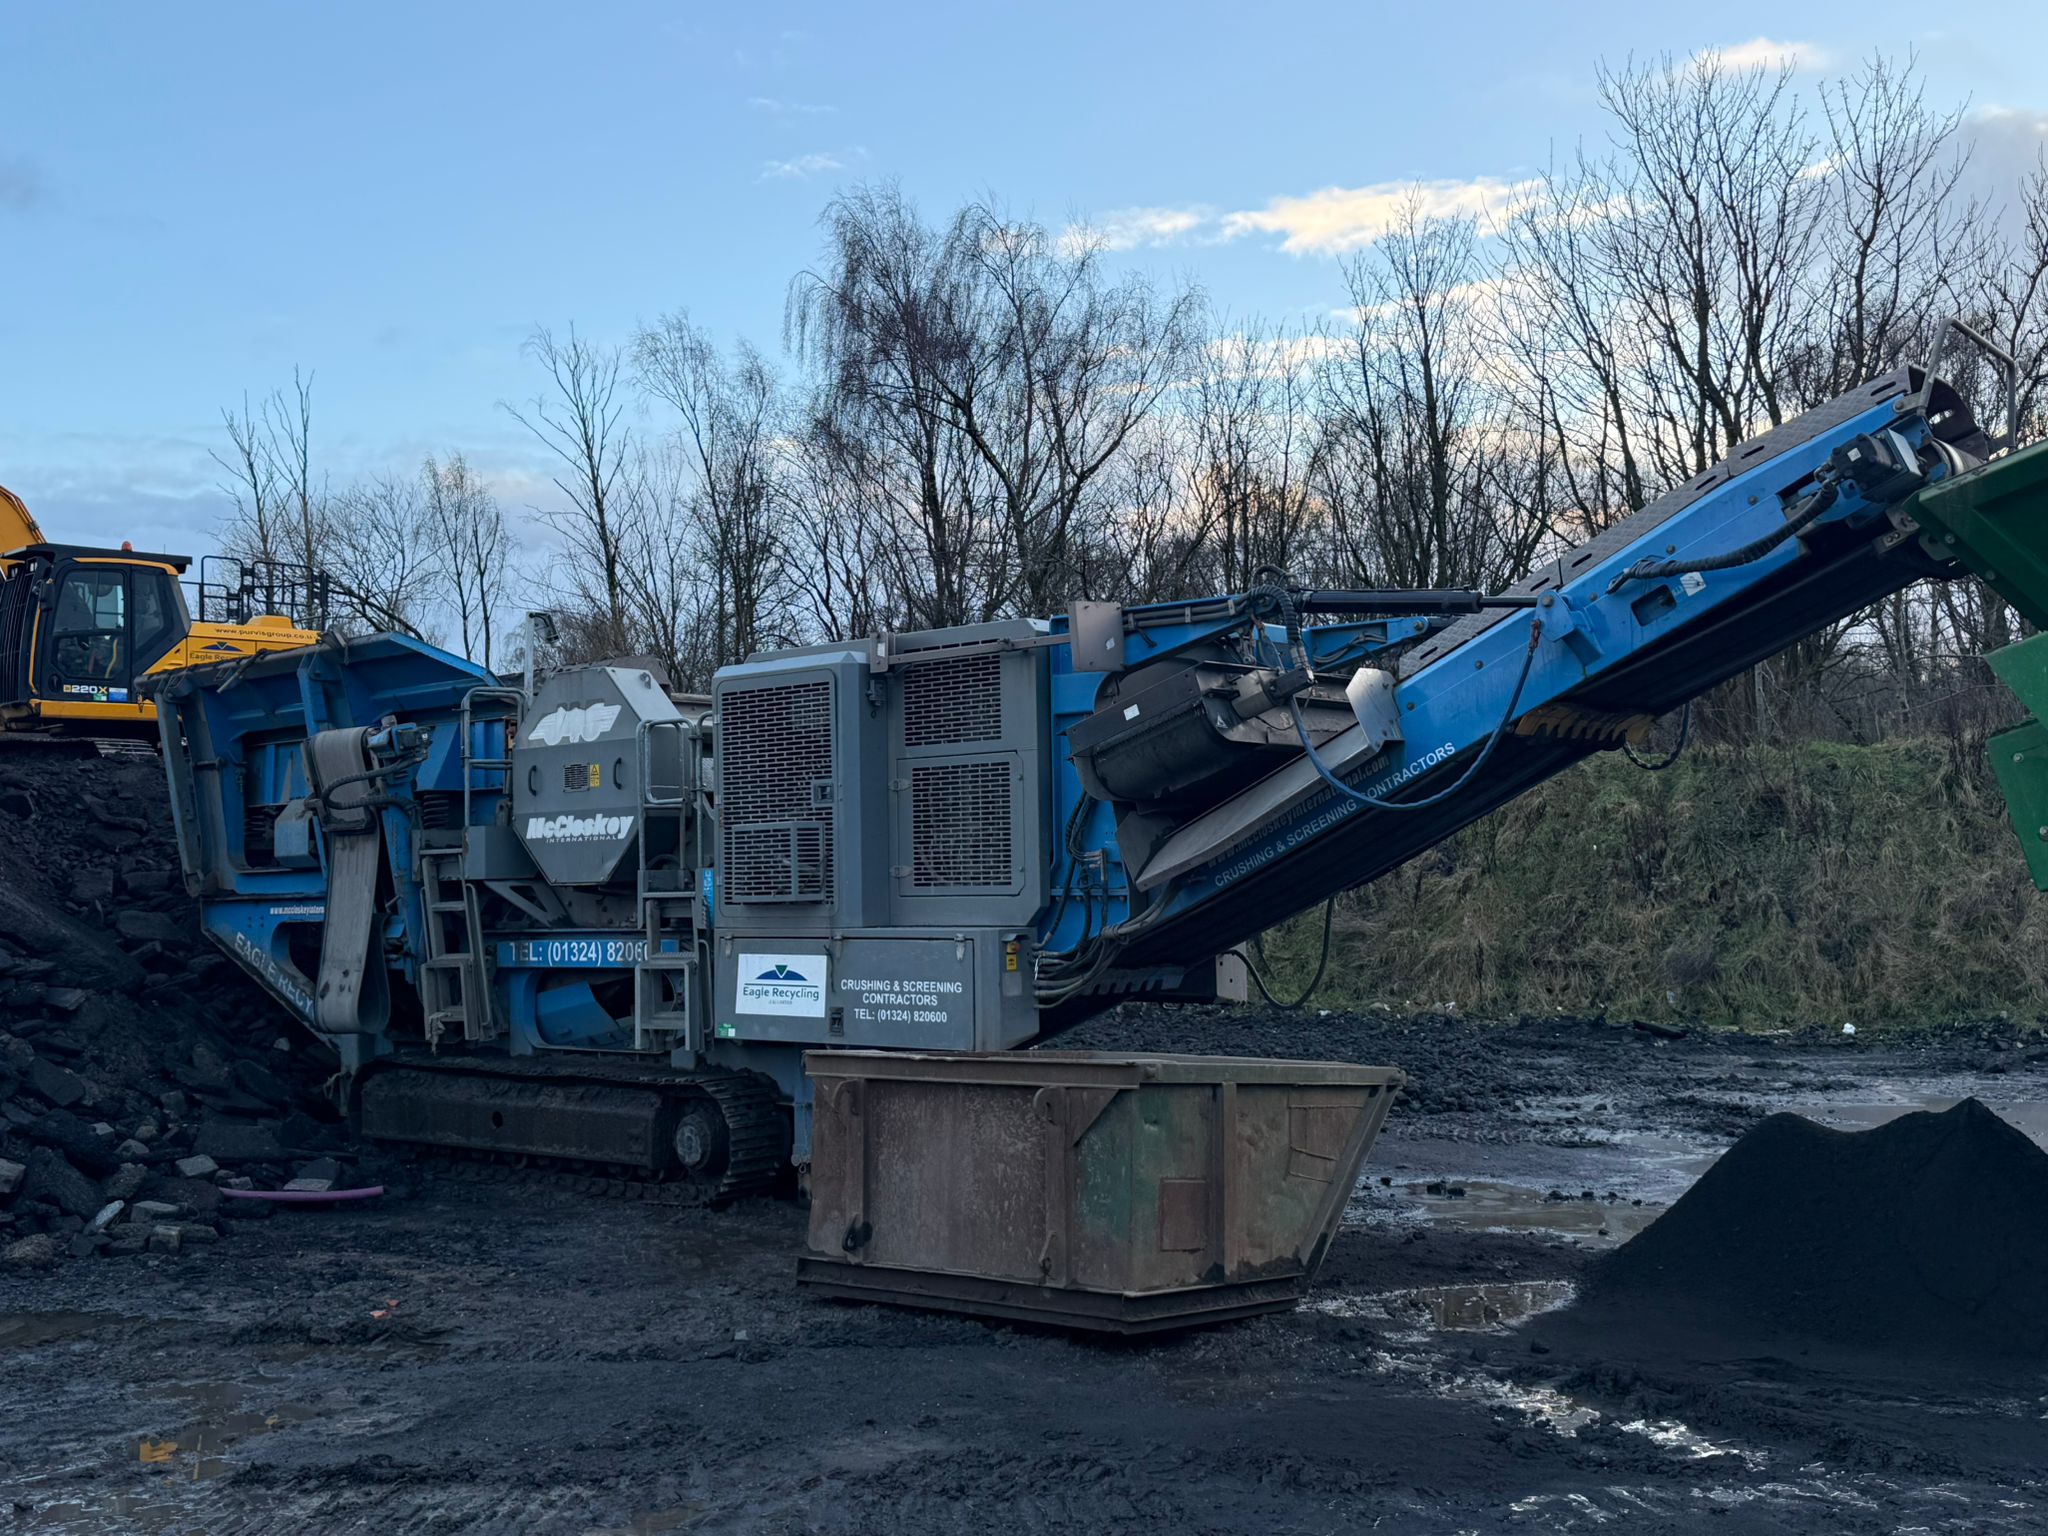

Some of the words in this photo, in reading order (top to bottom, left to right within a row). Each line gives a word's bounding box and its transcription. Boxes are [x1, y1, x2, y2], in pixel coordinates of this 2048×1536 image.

[1214, 845, 1275, 888] CRUSHING
[1276, 839, 1287, 853] &
[1287, 799, 1358, 848] SCREENING
[1360, 742, 1456, 800] ONTRACTORS
[526, 813, 634, 839] McCloskey
[546, 836, 616, 844] INTERNATIONAL
[234, 931, 277, 982] EAGLE
[509, 941, 543, 961] TEL:
[548, 940, 602, 967] (01324)
[743, 986, 770, 999] Eagle
[772, 987, 820, 1002] Recycling
[841, 979, 891, 991] CRUSHING
[893, 980, 900, 991] &
[902, 980, 963, 993] SCREENING
[862, 993, 938, 1006] CONTRACTORS
[854, 1008, 875, 1020] TEL:
[877, 1009, 911, 1024] (01324)
[913, 1010, 947, 1023] 820600
